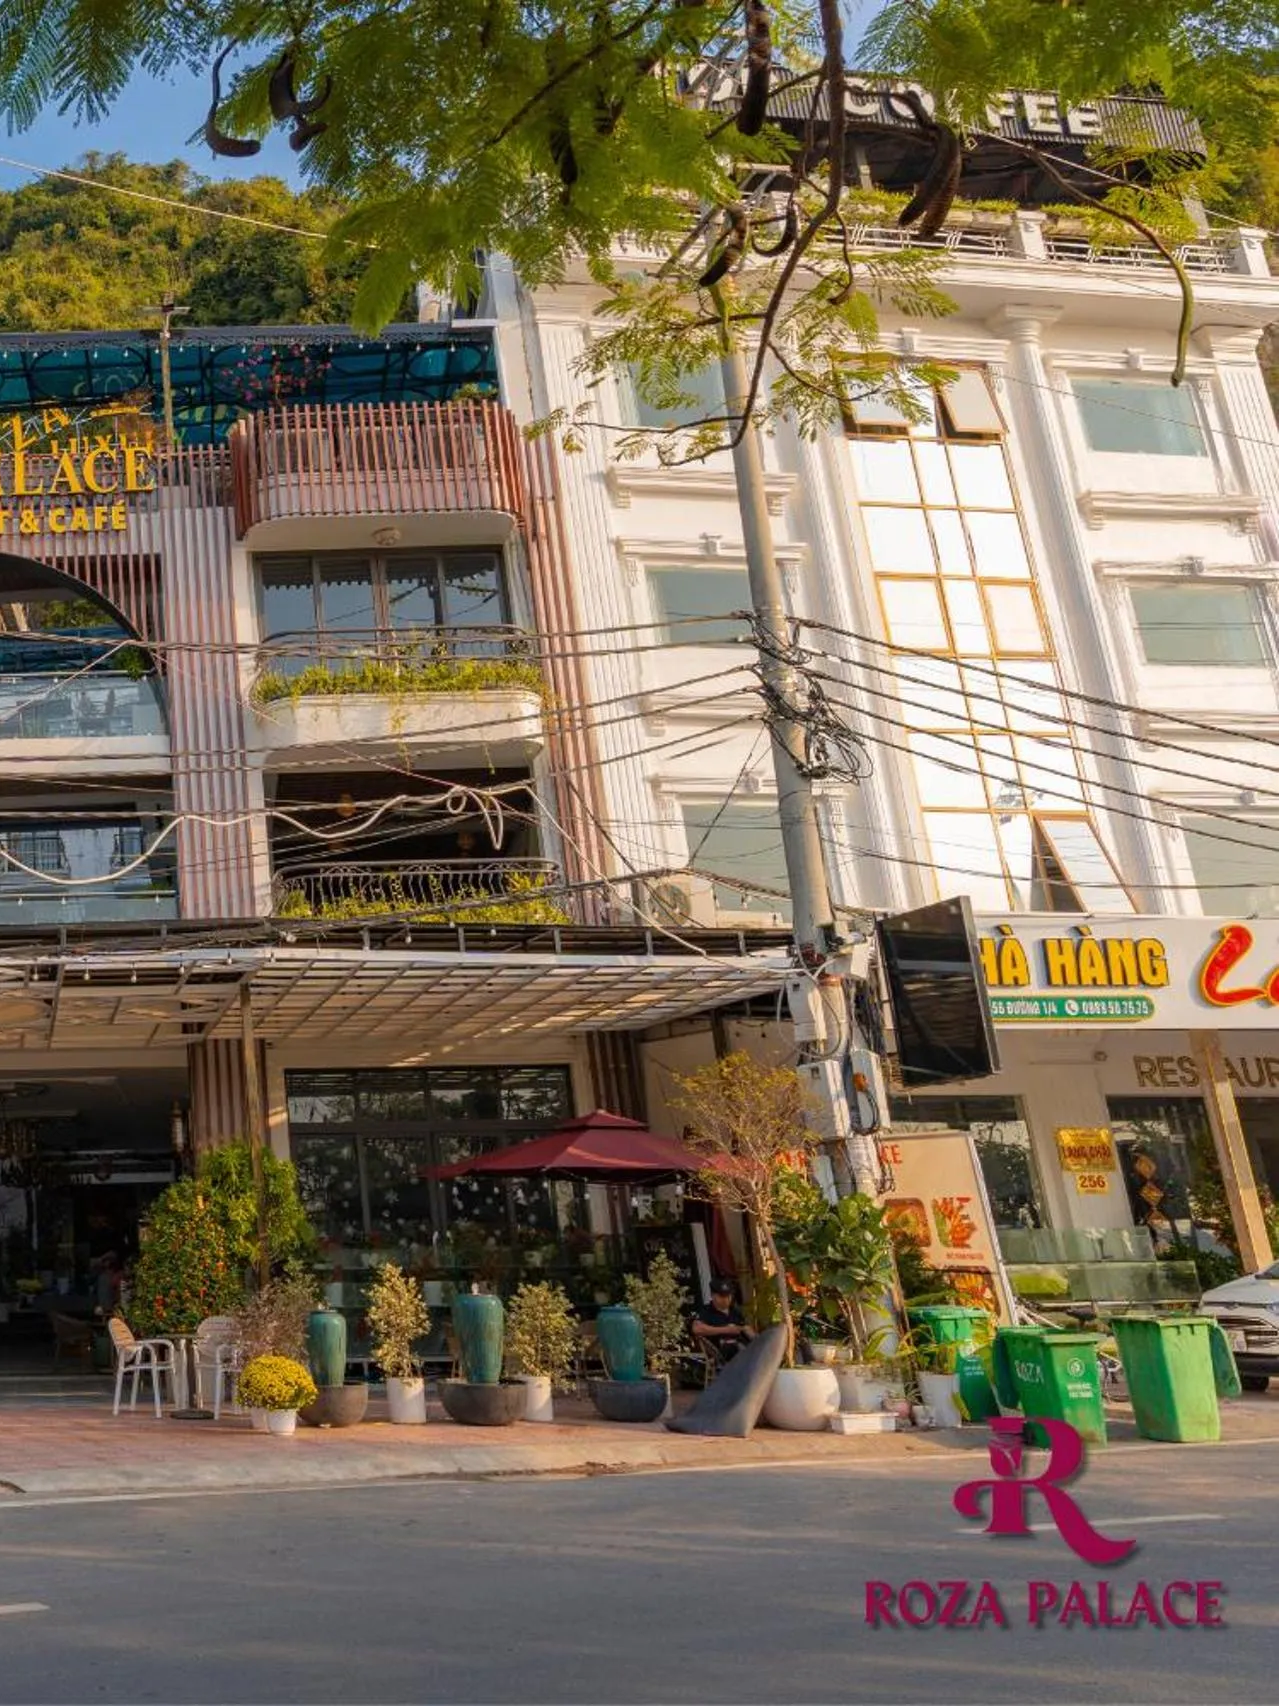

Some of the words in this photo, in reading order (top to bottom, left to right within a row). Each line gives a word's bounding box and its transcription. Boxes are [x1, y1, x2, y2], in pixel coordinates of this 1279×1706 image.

[842, 73, 1102, 138] COFEE
[20, 509, 40, 534] &
[49, 501, 127, 532] CAFÉ
[978, 924, 1031, 987] HÀ
[1043, 924, 1169, 987] HÀNG
[990, 1001, 1005, 1015] 56
[1133, 1055, 1279, 1088] RESAUR
[1079, 1174, 1106, 1189] 256
